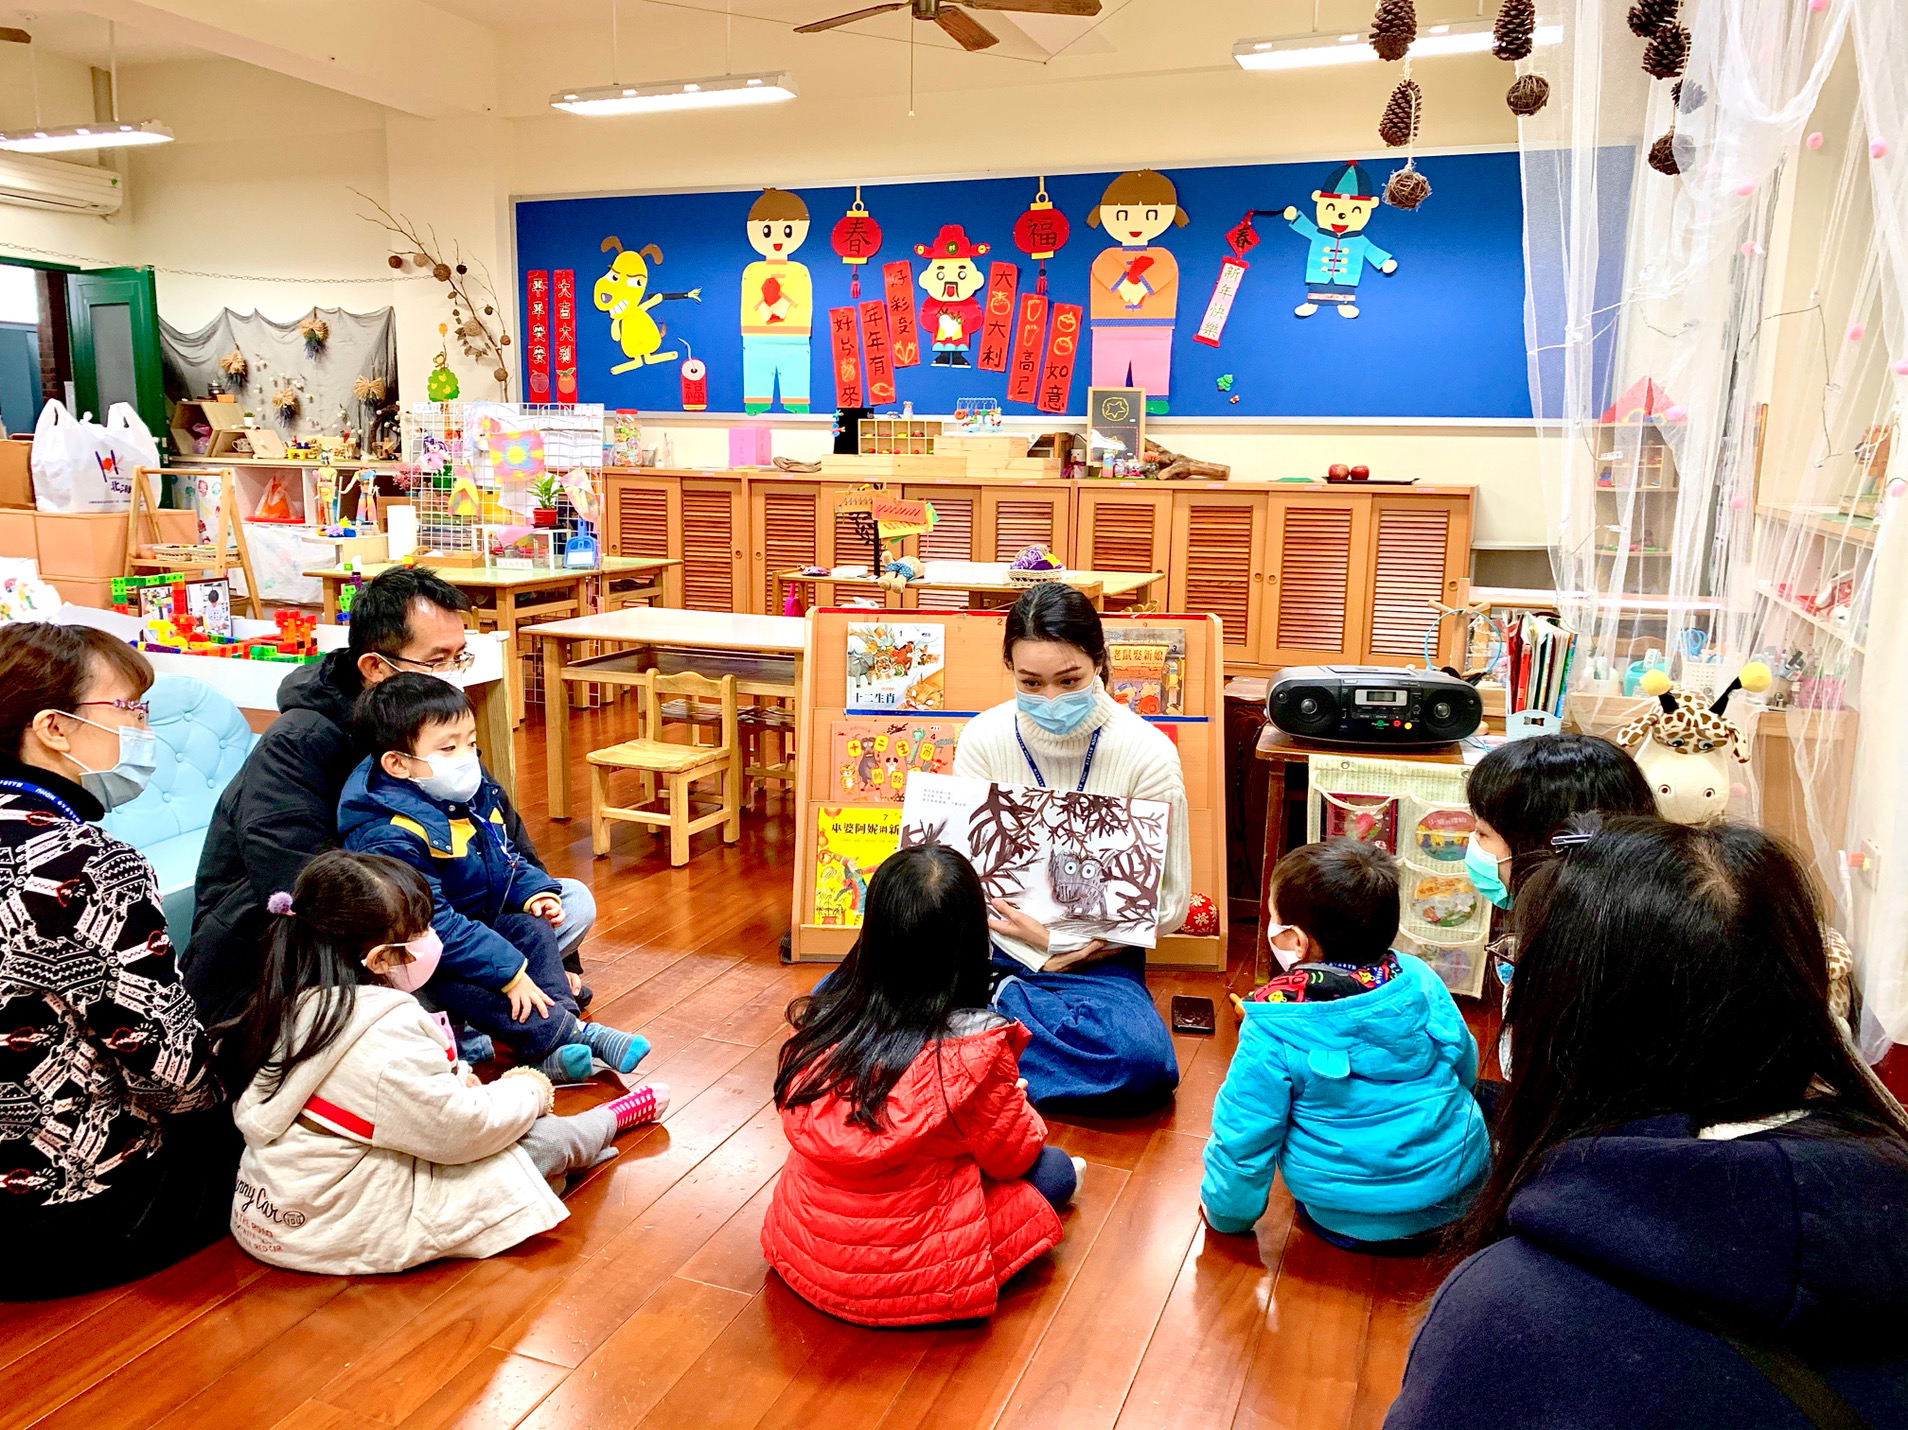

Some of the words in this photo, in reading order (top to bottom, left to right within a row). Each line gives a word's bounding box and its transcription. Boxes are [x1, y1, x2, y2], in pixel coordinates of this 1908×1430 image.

[842, 218, 872, 255] 春
[1026, 217, 1058, 247] 福
[1235, 225, 1253, 249] 春
[994, 270, 1013, 289] 大
[1204, 264, 1240, 338] 新年快樂
[531, 277, 546, 364] 平平安安
[557, 278, 574, 364] 大吉大利
[863, 306, 885, 376] 年年有
[1043, 361, 1069, 412] 如意
[996, 617, 1003, 626] 2
[1114, 649, 1163, 661] 老鼠娶新娘
[1170, 644, 1178, 652] 3
[853, 691, 895, 704] 十二生肖
[883, 813, 889, 821] 7
[256, 1187, 283, 1224] Car
